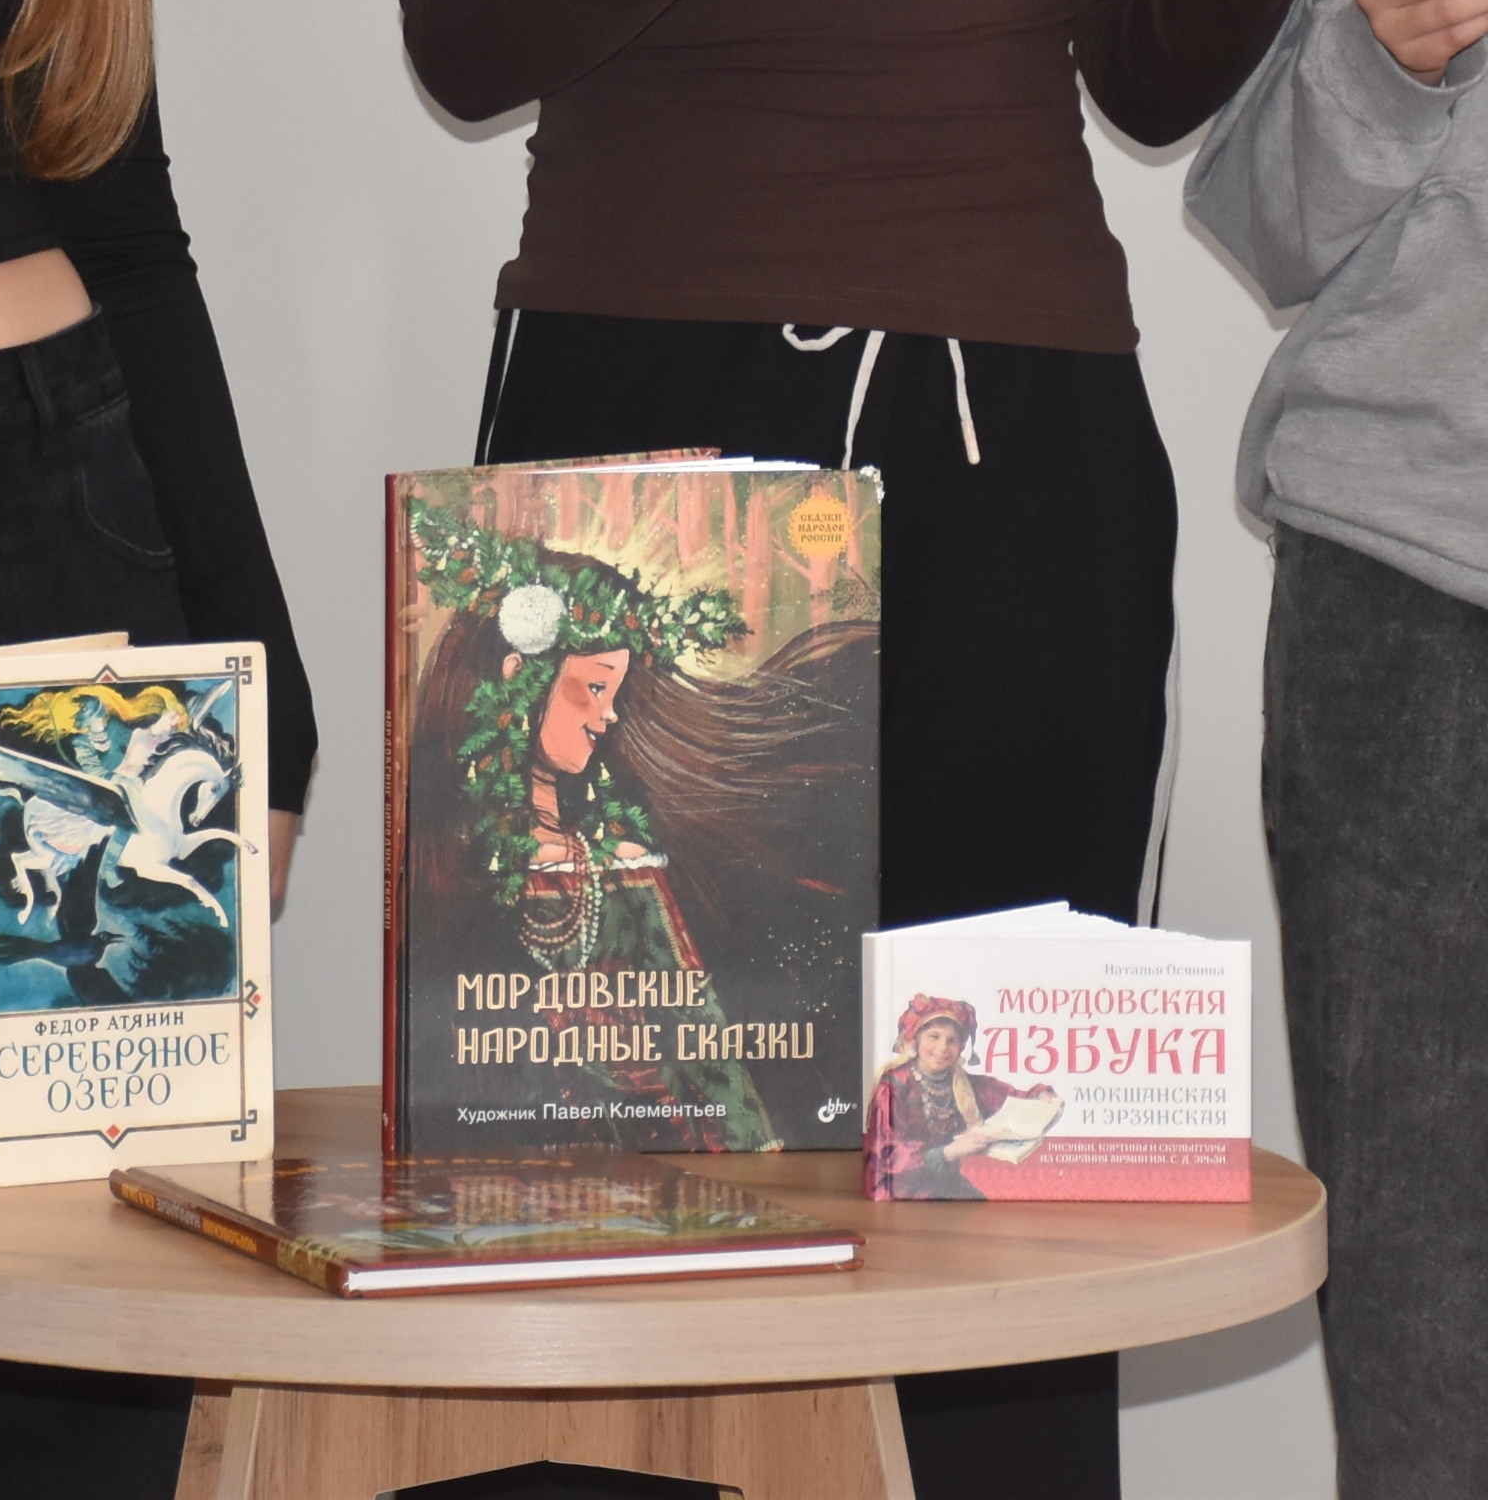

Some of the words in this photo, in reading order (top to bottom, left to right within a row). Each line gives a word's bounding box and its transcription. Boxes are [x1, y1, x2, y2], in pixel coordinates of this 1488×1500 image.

[798, 524, 845, 533] НАРОДОВ
[800, 513, 842, 522] СКАЗКИ
[800, 534, 842, 543] РОССИИ
[1104, 963, 1163, 977] Наталья
[1166, 963, 1225, 977] Осянина
[457, 970, 706, 1014] МОРДОВСКИЕ
[997, 986, 1226, 1019] МОРДОВСКАЯ
[34, 1017, 100, 1037] ФЕДОР
[106, 1011, 185, 1033] АТЯНИН
[457, 1024, 662, 1067] НАРОДНЫЕ
[677, 1022, 814, 1062] СКАЗКИ
[982, 1025, 1226, 1075] АЗБУКА
[47, 1073, 171, 1113] ОЗЕРО
[1073, 1086, 1227, 1105] МОКШАНСКАЯ
[457, 1107, 537, 1125] Художник
[543, 1103, 604, 1120] Павел
[610, 1102, 726, 1118] Клементьев
[1082, 1109, 1095, 1125] И
[1103, 1109, 1227, 1126] ЭРЗЯНСКАЯ
